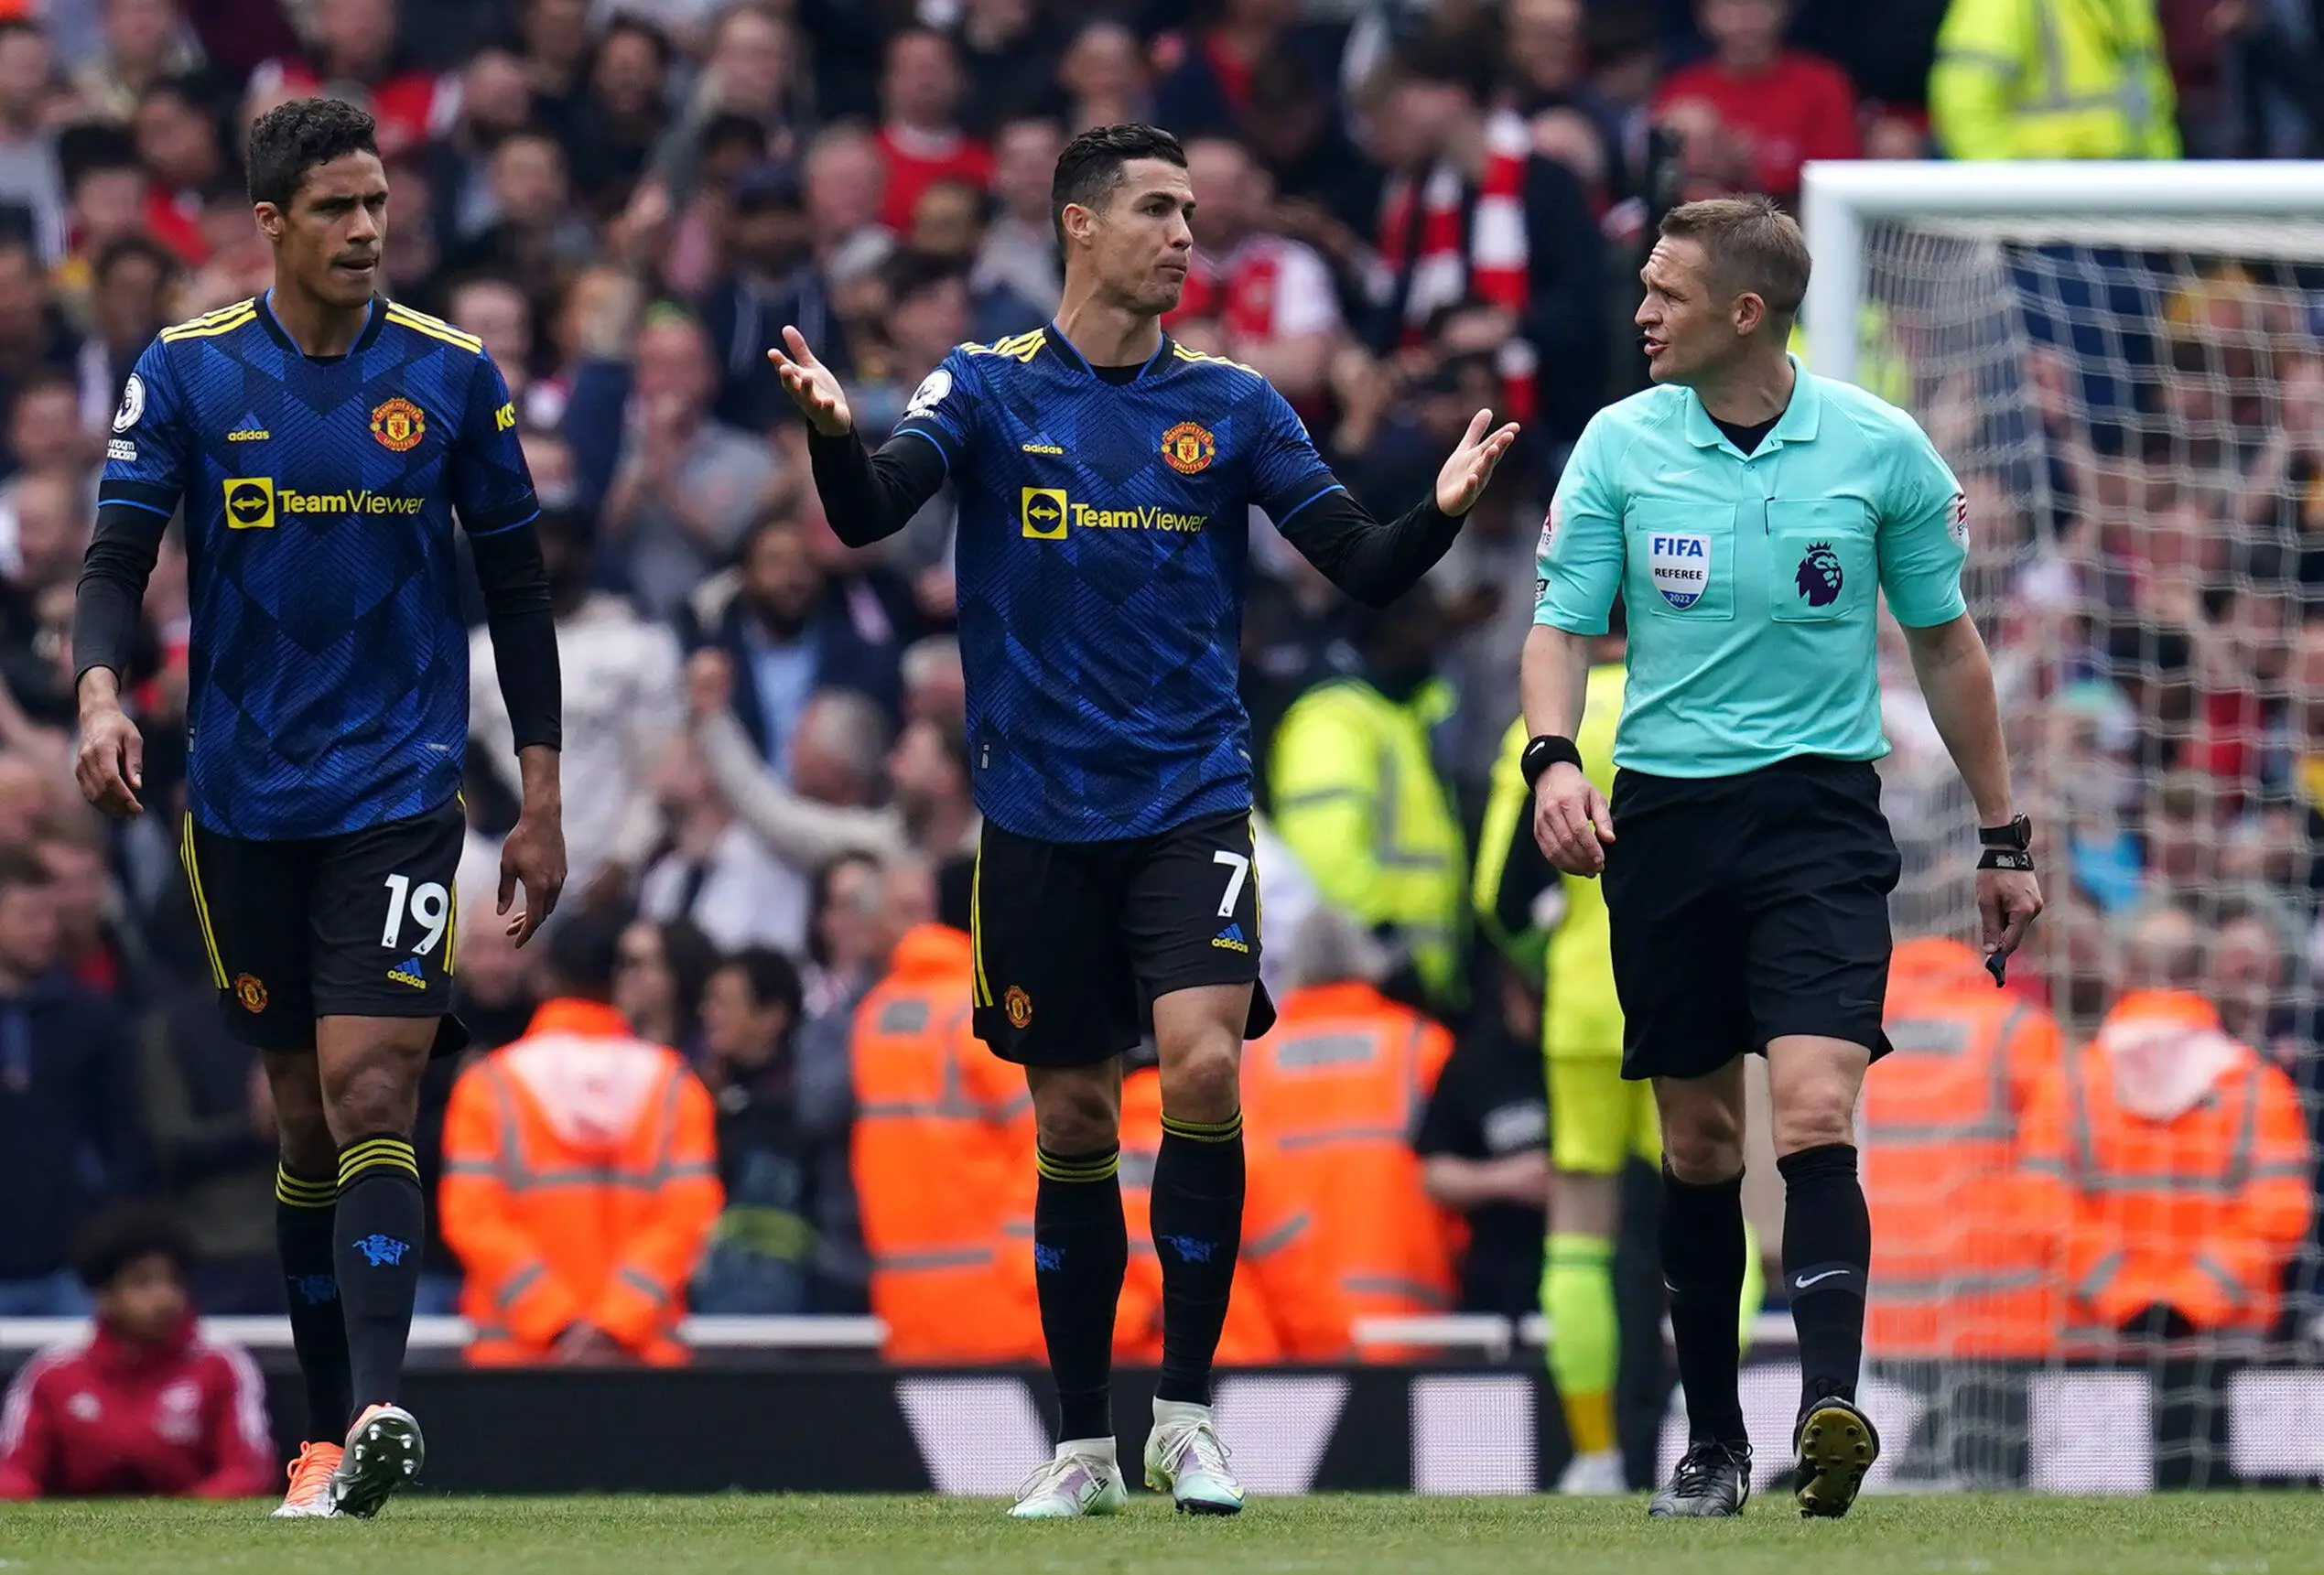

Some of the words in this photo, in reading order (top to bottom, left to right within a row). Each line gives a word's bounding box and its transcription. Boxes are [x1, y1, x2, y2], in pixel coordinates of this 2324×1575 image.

[228, 428, 270, 441] adidas
[383, 437, 416, 448] UNITED
[1021, 443, 1064, 455] adidas
[1173, 459, 1205, 470] UNITED
[277, 490, 425, 515] TeamViewer
[1070, 503, 1207, 533] TeamViewer
[1653, 537, 1703, 557] FIFA
[1654, 567, 1702, 580] REFEREE
[1669, 593, 1691, 603] 2022
[1213, 850, 1249, 918] 7
[381, 873, 449, 956] 19
[1211, 938, 1249, 954] adidas
[387, 968, 427, 989] adidas
